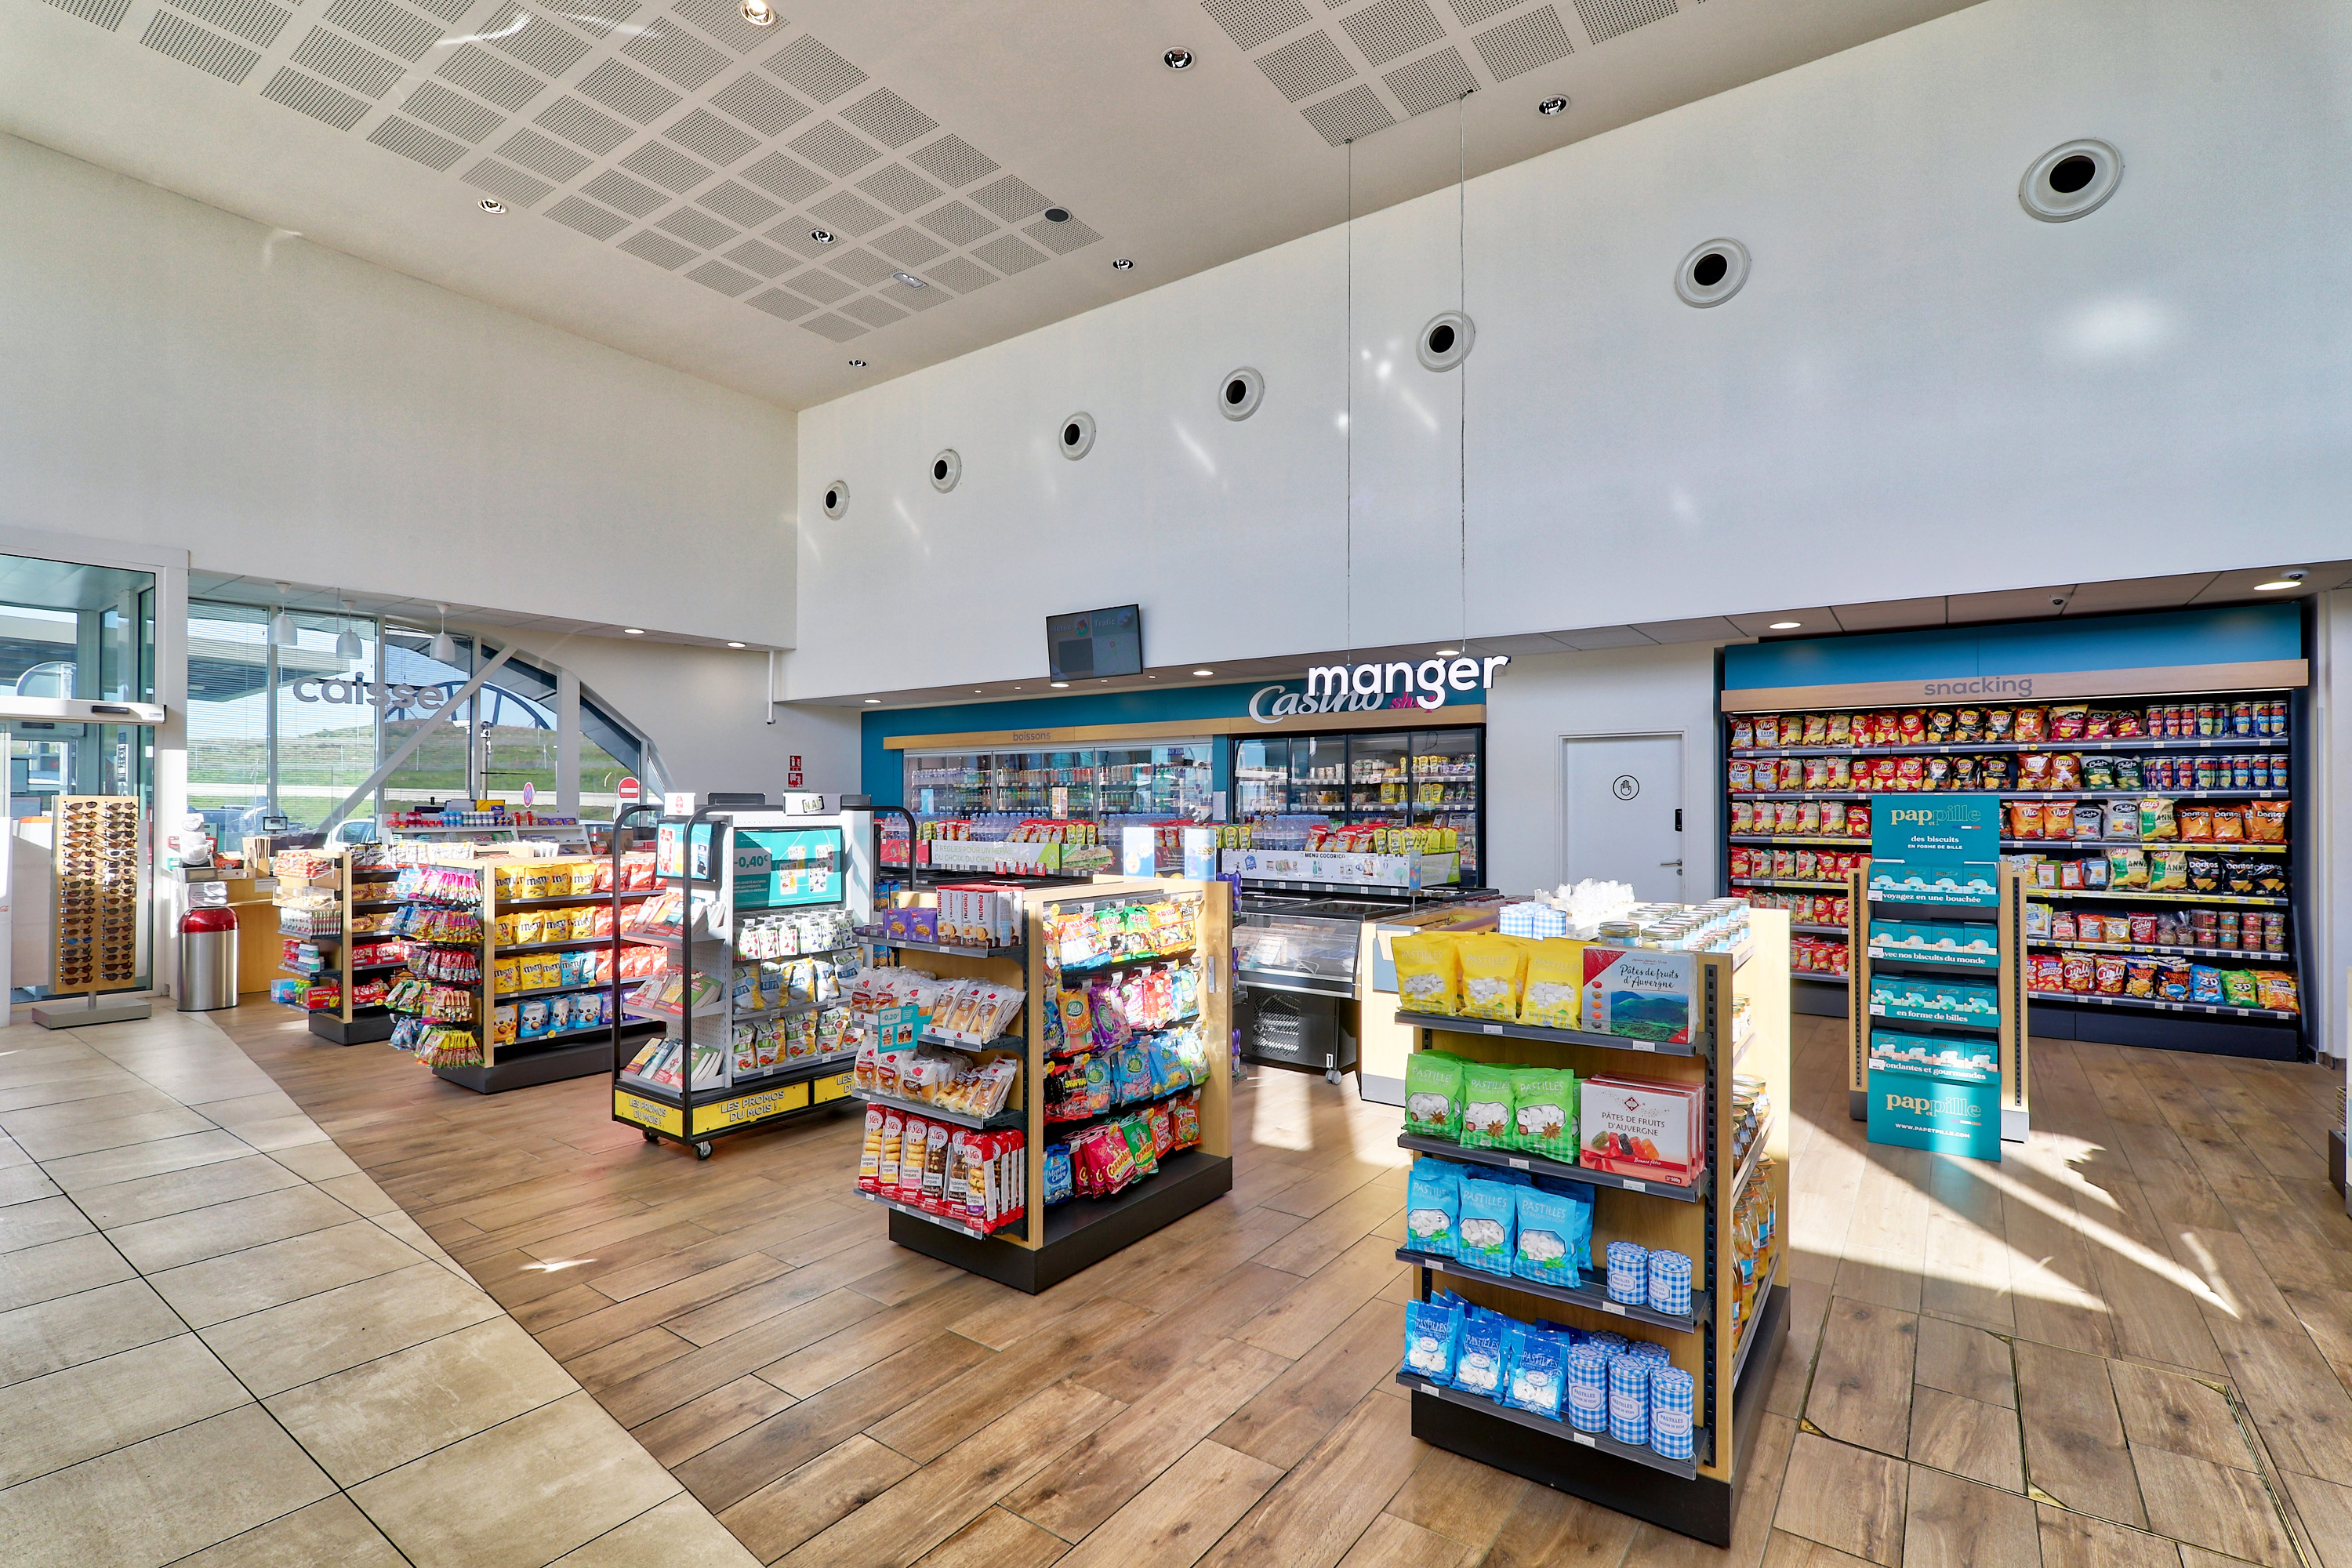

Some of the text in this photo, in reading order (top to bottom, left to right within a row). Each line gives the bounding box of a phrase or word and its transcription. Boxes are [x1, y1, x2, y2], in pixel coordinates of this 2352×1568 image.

[1093, 619, 1116, 628] Trafic
[1308, 655, 1510, 710] manger
[1924, 676, 2033, 698] snacking
[292, 671, 444, 710] caisse
[1013, 731, 1051, 742] boissons
[1882, 892, 1914, 901] voyagez
[1946, 895, 1981, 903] bouchée
[2132, 920, 2151, 929] Curly
[1402, 950, 1443, 959] PASTILLES
[1466, 953, 1511, 964] PASTILLES
[1913, 953, 1943, 961] biscuits
[1957, 956, 1986, 964] monde
[1534, 957, 1581, 971] PASTILLES
[2064, 964, 2089, 979] Curly
[1620, 964, 1644, 976] Pâtes
[1656, 967, 1679, 980] fruits
[2096, 965, 2125, 981] Curly
[1412, 1067, 1453, 1083] PASTILLES
[1883, 1062, 1922, 1072] fondantes
[1933, 1068, 1986, 1080] gourmandes
[837, 1074, 853, 1085] LES
[1472, 1079, 1512, 1090] PASTILLES
[1520, 1081, 1563, 1091] PASTILLES
[629, 1097, 666, 1117] LES PROMOS
[721, 1090, 785, 1113] LES PROMOS
[634, 1110, 643, 1120] DU
[644, 1112, 659, 1125] MOIS
[730, 1110, 745, 1122] DU
[747, 1103, 771, 1117] MOIS
[1602, 1111, 1624, 1121] PÂTES
[1639, 1117, 1665, 1128] FRUITS
[1608, 1122, 1658, 1137] D'AUVERGNE
[1895, 1123, 1970, 1138] WWW.PAPETPILLE.COM
[1634, 1157, 1650, 1166] Bonnes
[1414, 1181, 1450, 1198] PASTILLES
[1464, 1190, 1507, 1207] PASTILLES
[1522, 1200, 1566, 1218] PASTILLES
[1416, 1318, 1447, 1333] PASTILLES
[1466, 1334, 1499, 1349] PASTILLES
[1523, 1350, 1558, 1368] PASTILLES
[1574, 1389, 1595, 1399] PASTILLES
[1612, 1399, 1633, 1409] PASTILLES
[1661, 1414, 1684, 1424] PASTILLES
